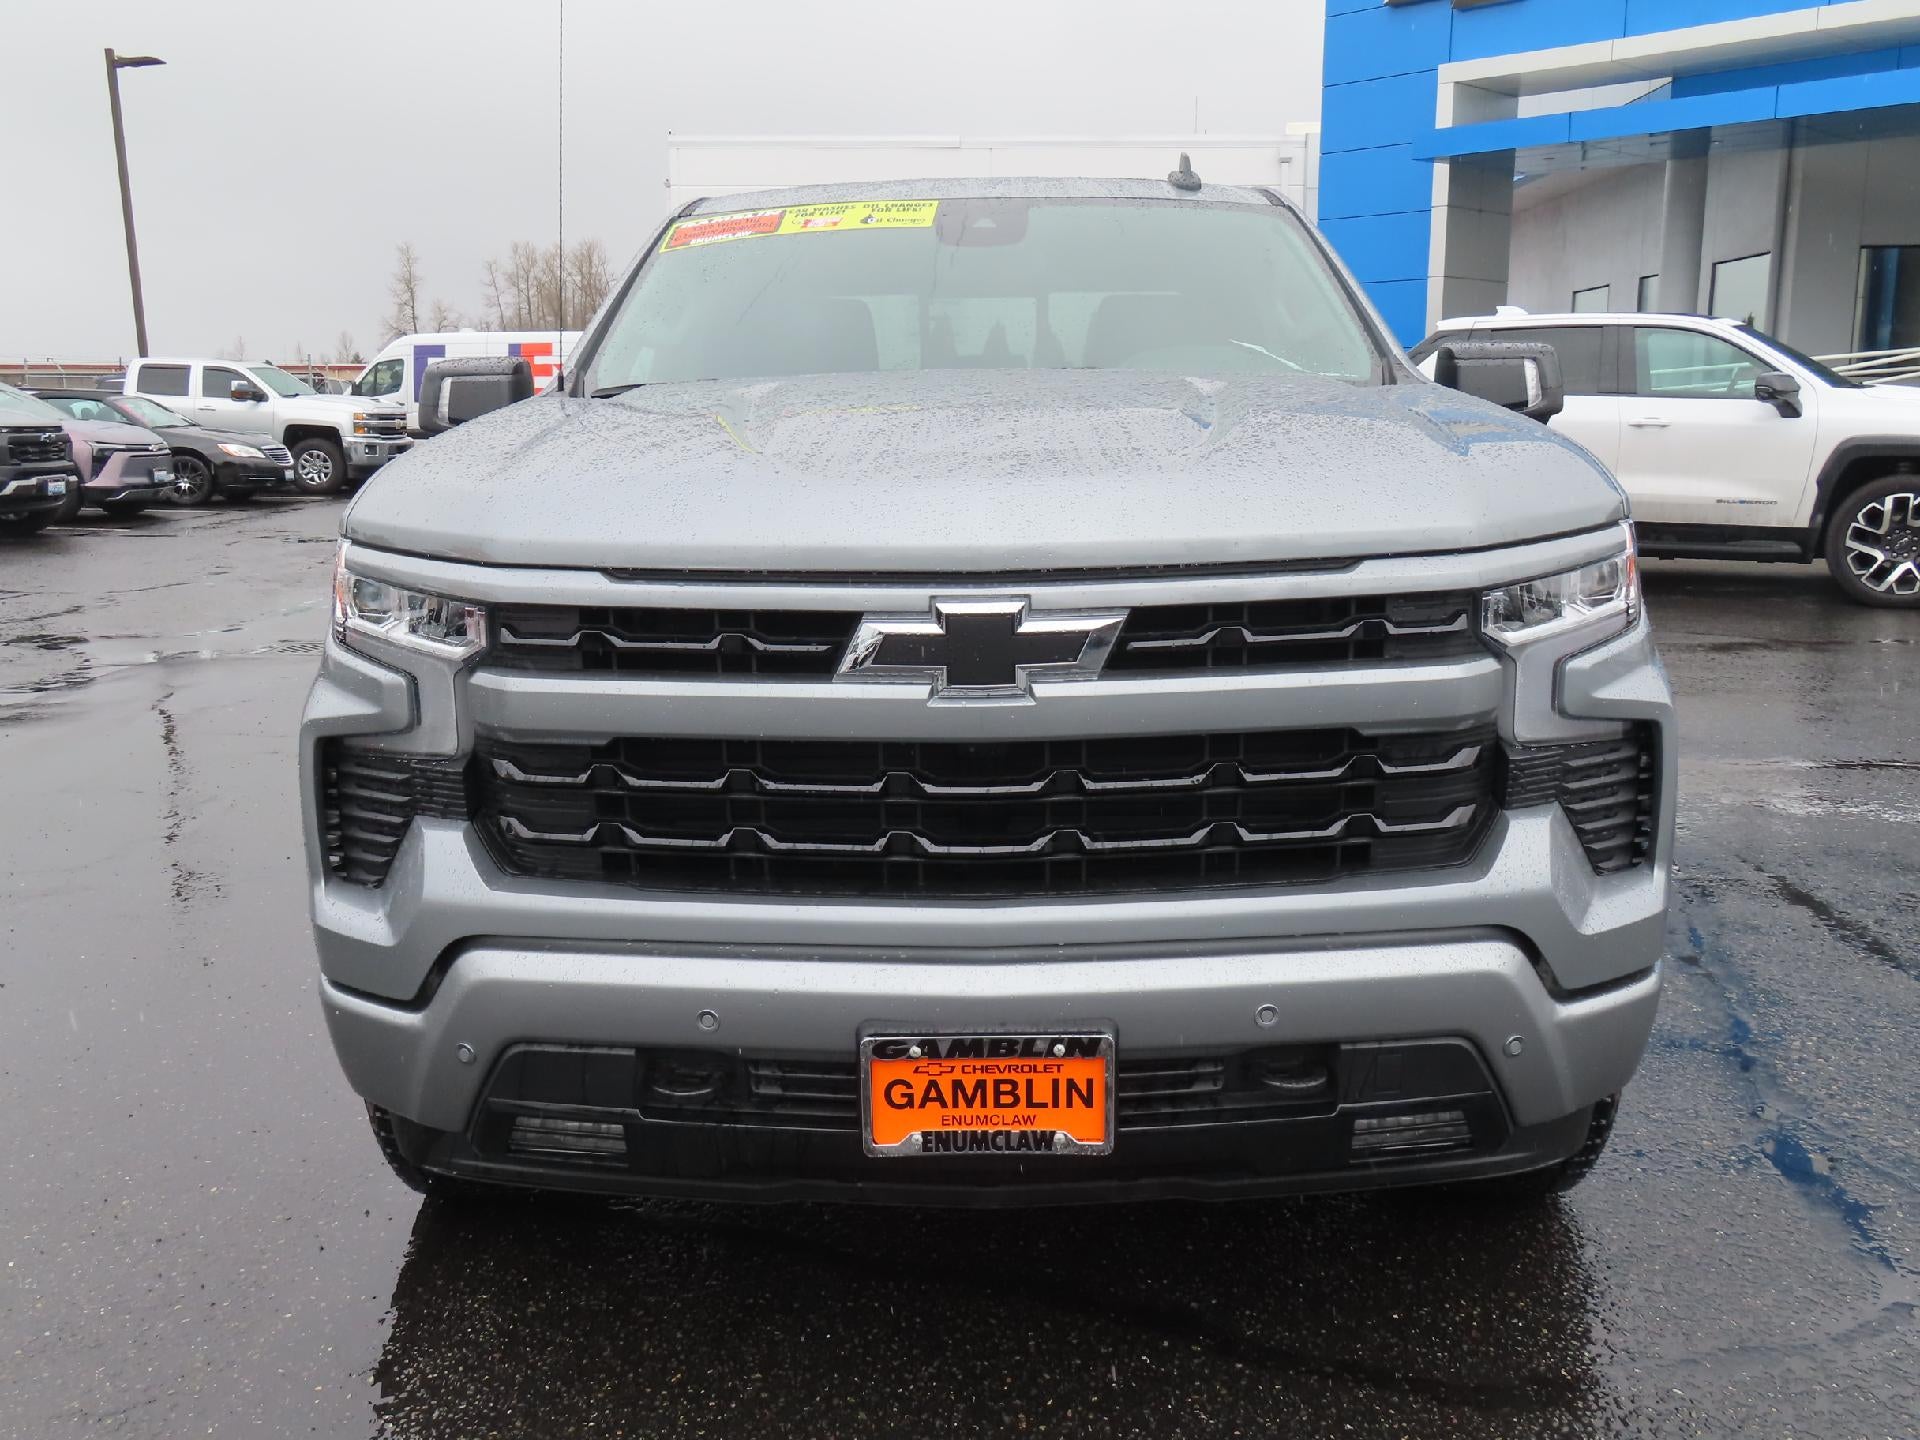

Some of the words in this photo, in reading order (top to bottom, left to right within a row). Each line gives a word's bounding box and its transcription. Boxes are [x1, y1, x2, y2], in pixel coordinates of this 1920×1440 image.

[872, 1038, 1103, 1059] GAMBLIN
[961, 1064, 1065, 1074] CHEVROLET
[883, 1078, 1094, 1109] GAMBLIN
[941, 1114, 1037, 1126] ENUMCLAW
[921, 1130, 1057, 1152] ENUMCLAW
